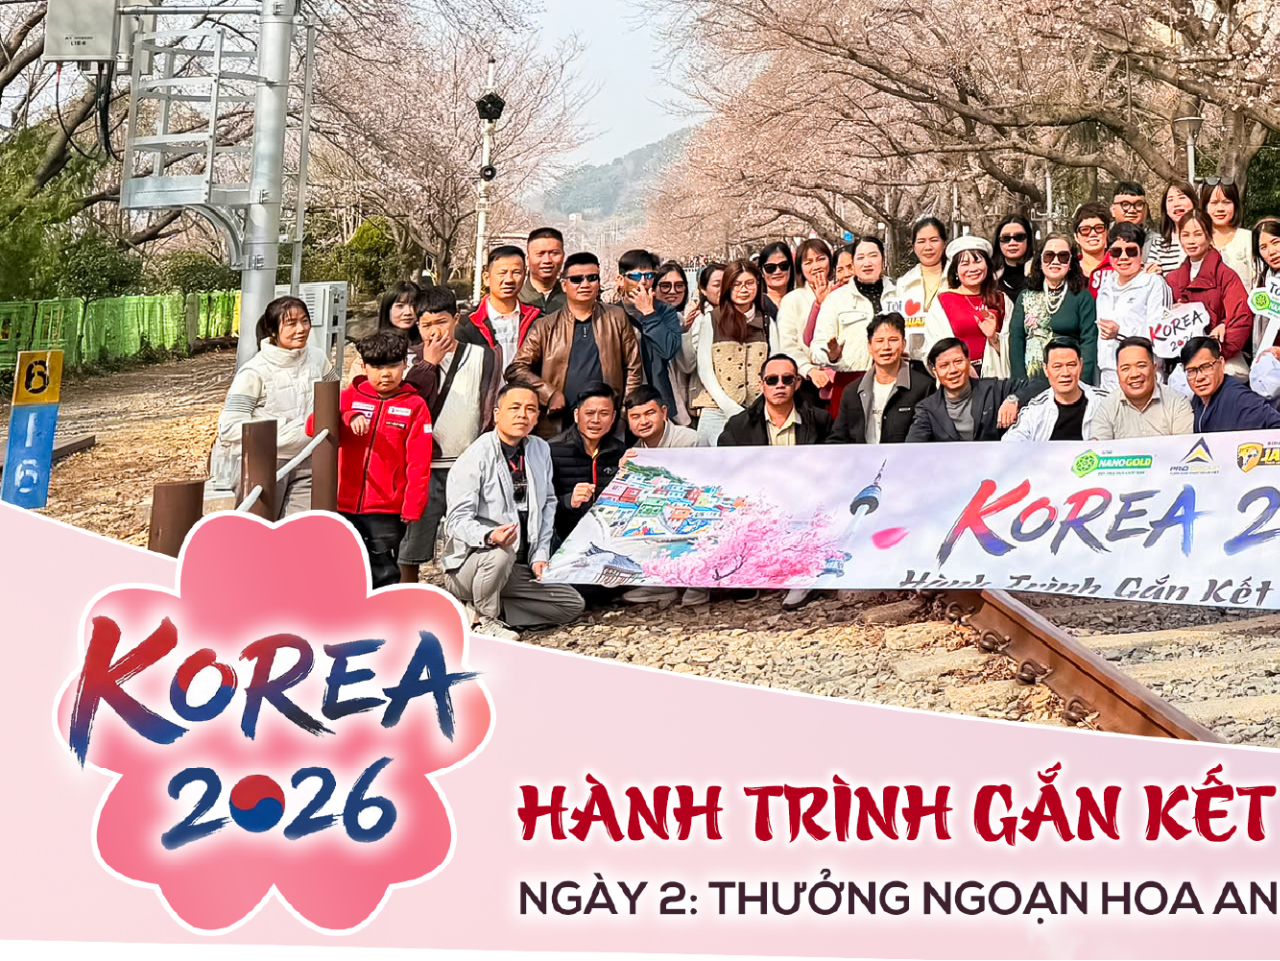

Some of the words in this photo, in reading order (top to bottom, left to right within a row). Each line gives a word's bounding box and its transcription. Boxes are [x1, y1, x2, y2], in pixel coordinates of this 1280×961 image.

[1149, 310, 1203, 342] KOREA
[25, 359, 50, 394] 6
[1099, 457, 1152, 468] NANOGOLD
[937, 478, 1213, 567] KOREA
[1113, 574, 1190, 601] Gắn
[1200, 576, 1274, 607] Kết
